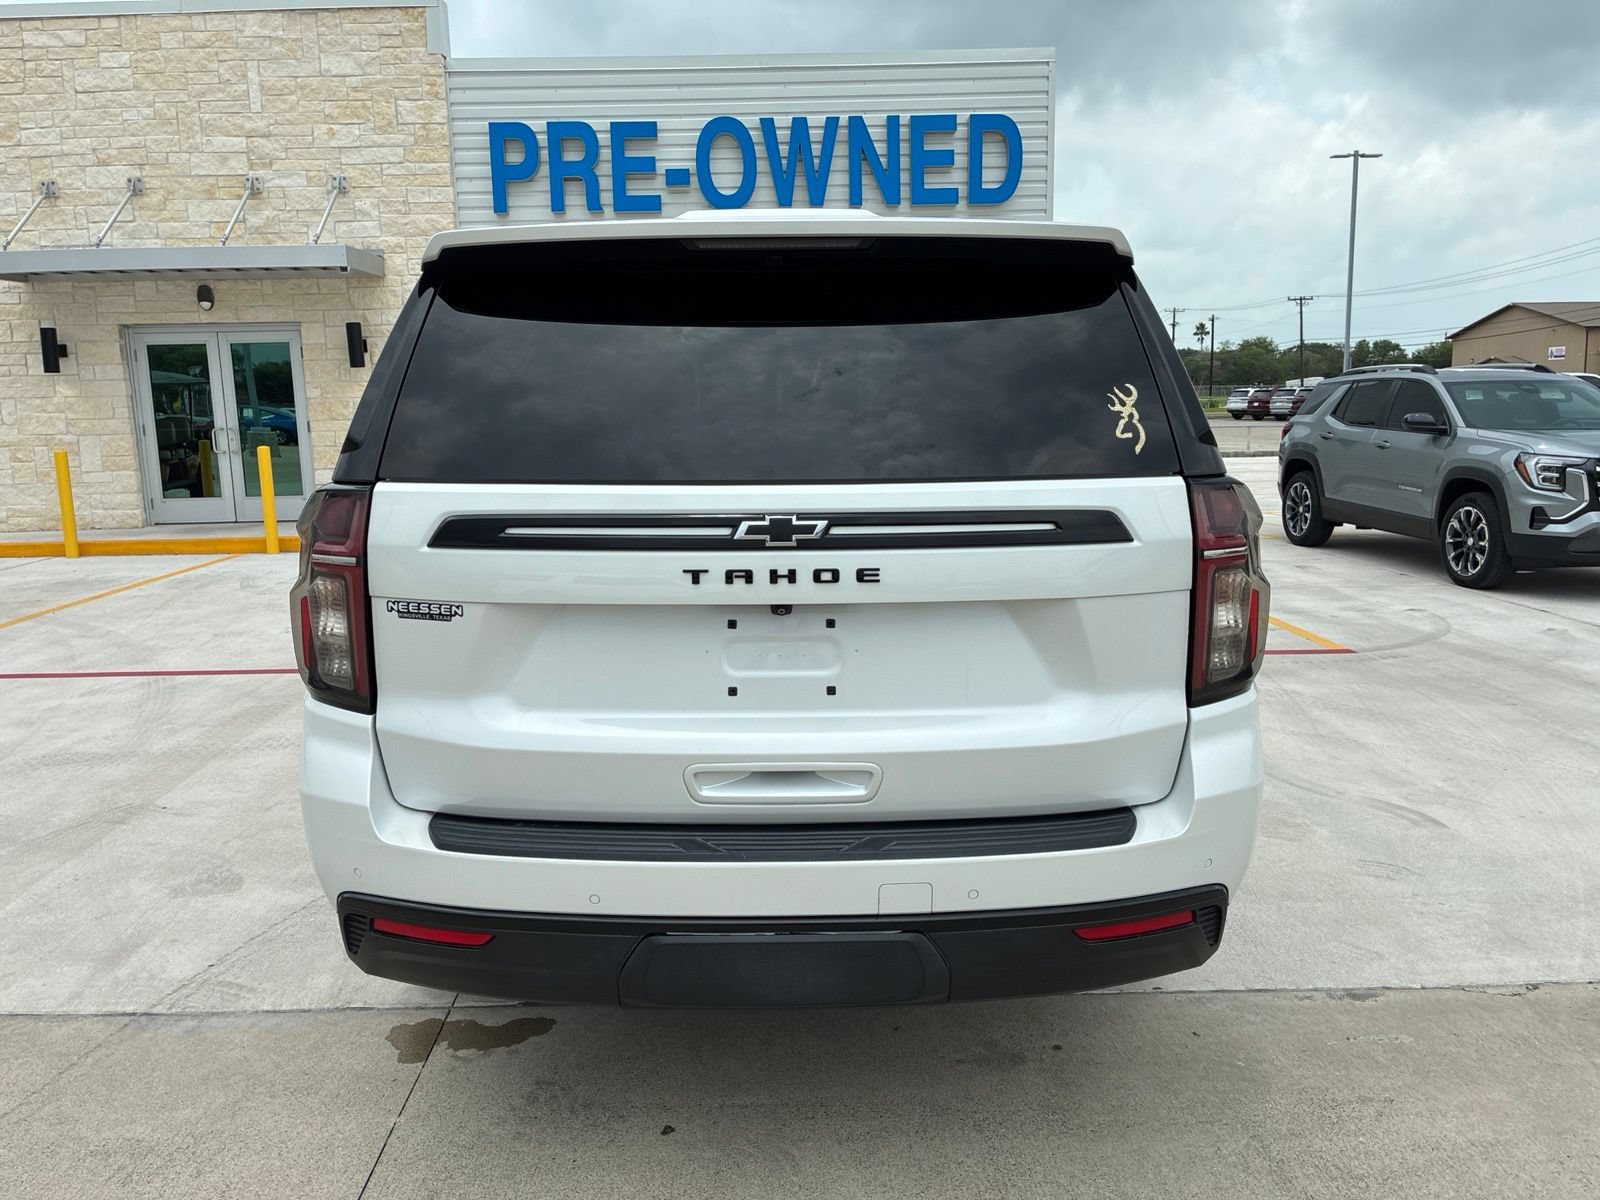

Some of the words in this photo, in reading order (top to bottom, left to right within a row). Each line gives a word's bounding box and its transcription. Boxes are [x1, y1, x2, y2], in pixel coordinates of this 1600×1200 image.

[488, 113, 1024, 213] PRE-OWNED
[682, 568, 880, 584] TAHOE
[387, 601, 463, 616] NEESSEN
